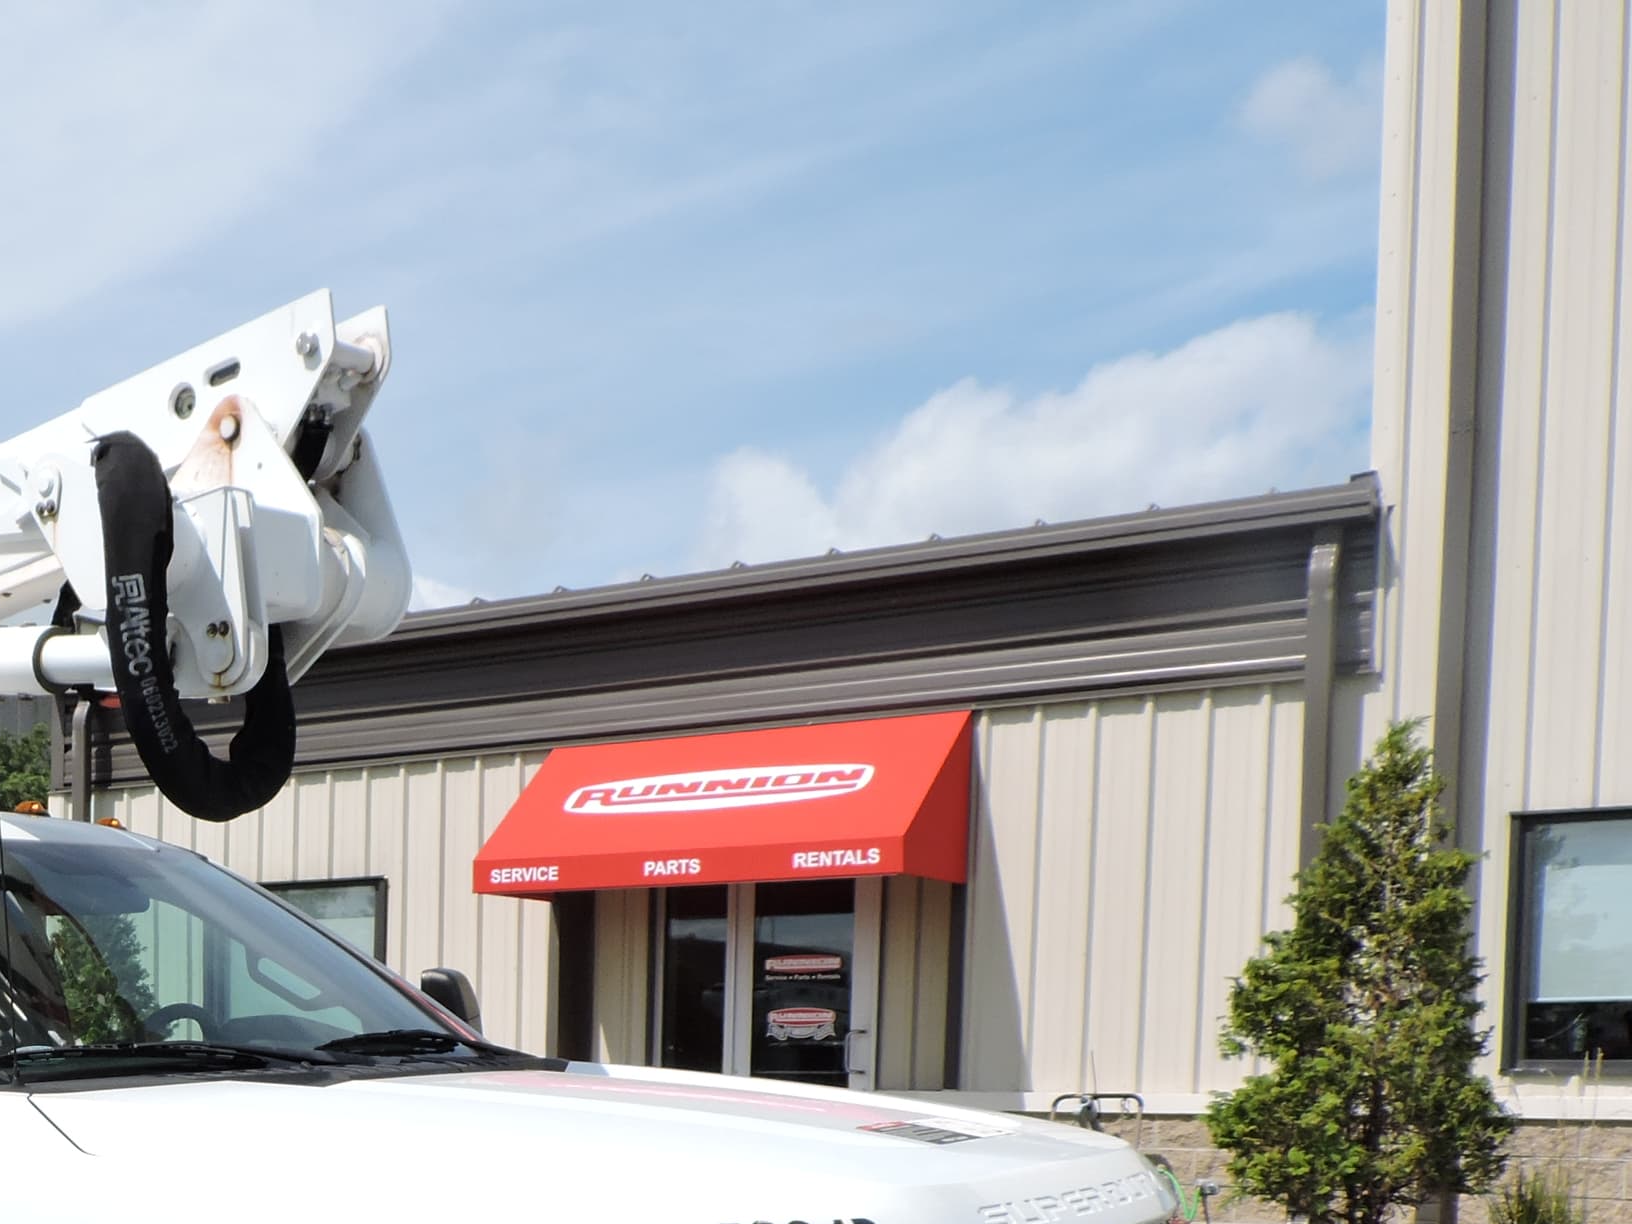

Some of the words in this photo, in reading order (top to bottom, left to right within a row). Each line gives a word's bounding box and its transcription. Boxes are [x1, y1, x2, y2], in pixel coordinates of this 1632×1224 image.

[119, 606, 153, 676] Altec
[571, 767, 867, 809] RUNNION
[490, 865, 559, 884] SERVICE
[643, 858, 701, 876] PARTS
[792, 847, 881, 868] RENTALS
